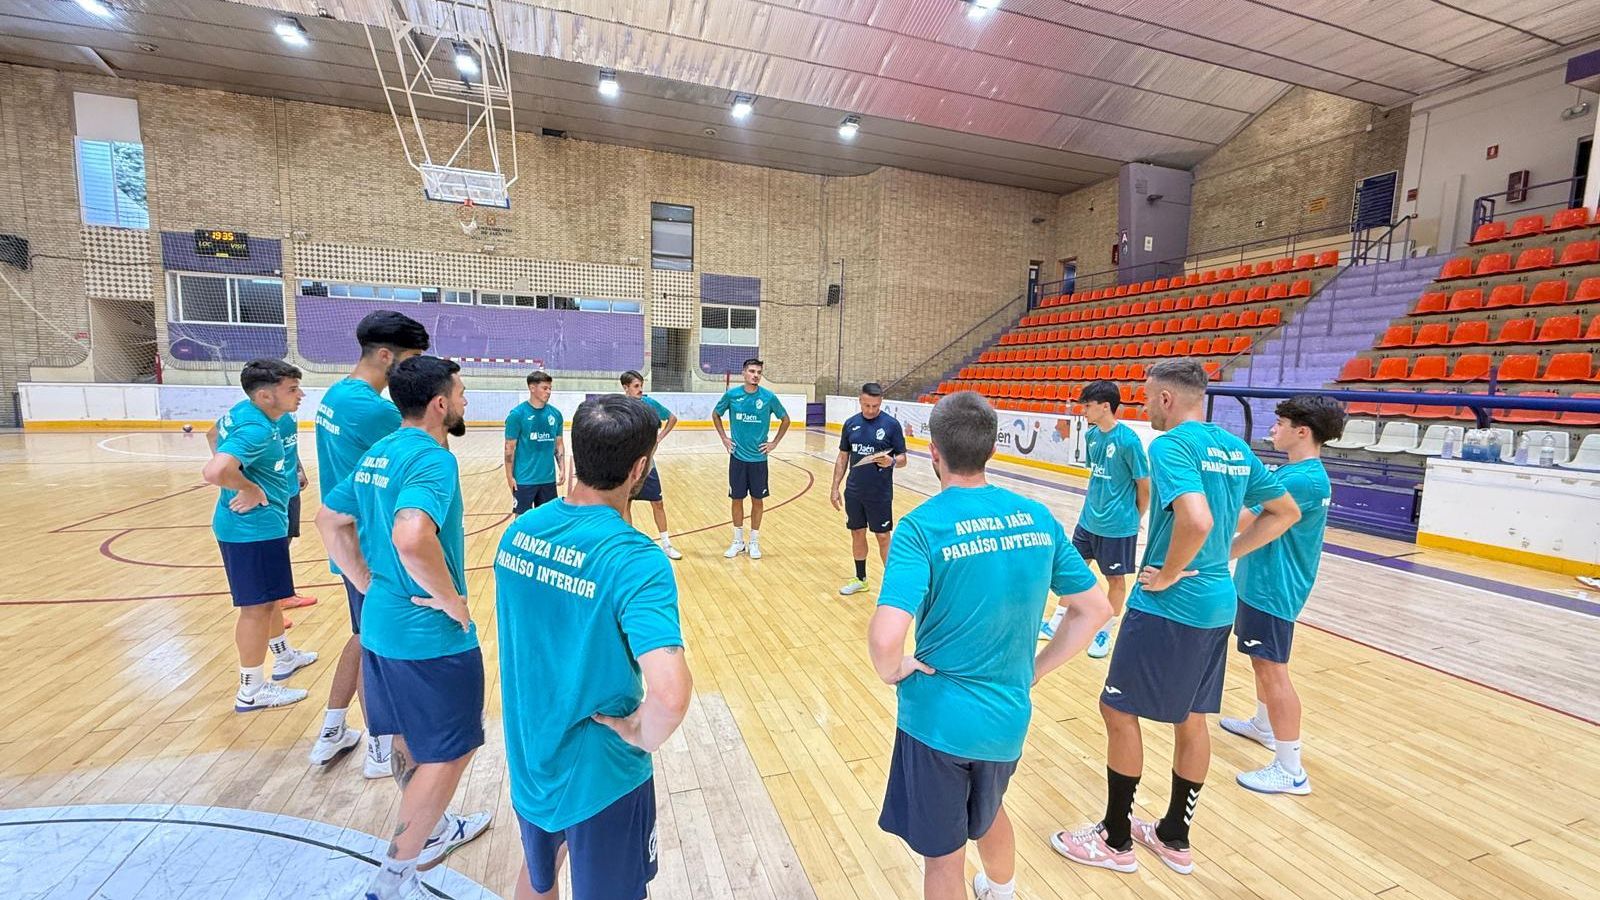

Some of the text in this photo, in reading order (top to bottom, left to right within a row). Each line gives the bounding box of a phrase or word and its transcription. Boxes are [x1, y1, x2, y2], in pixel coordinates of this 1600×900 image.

[954, 510, 1035, 536] AVANZA JAÉN
[552, 545, 587, 569] JAÉN
[941, 531, 1053, 562] PARAÍSO INTERIOR
[536, 565, 597, 599] INTERIOR
